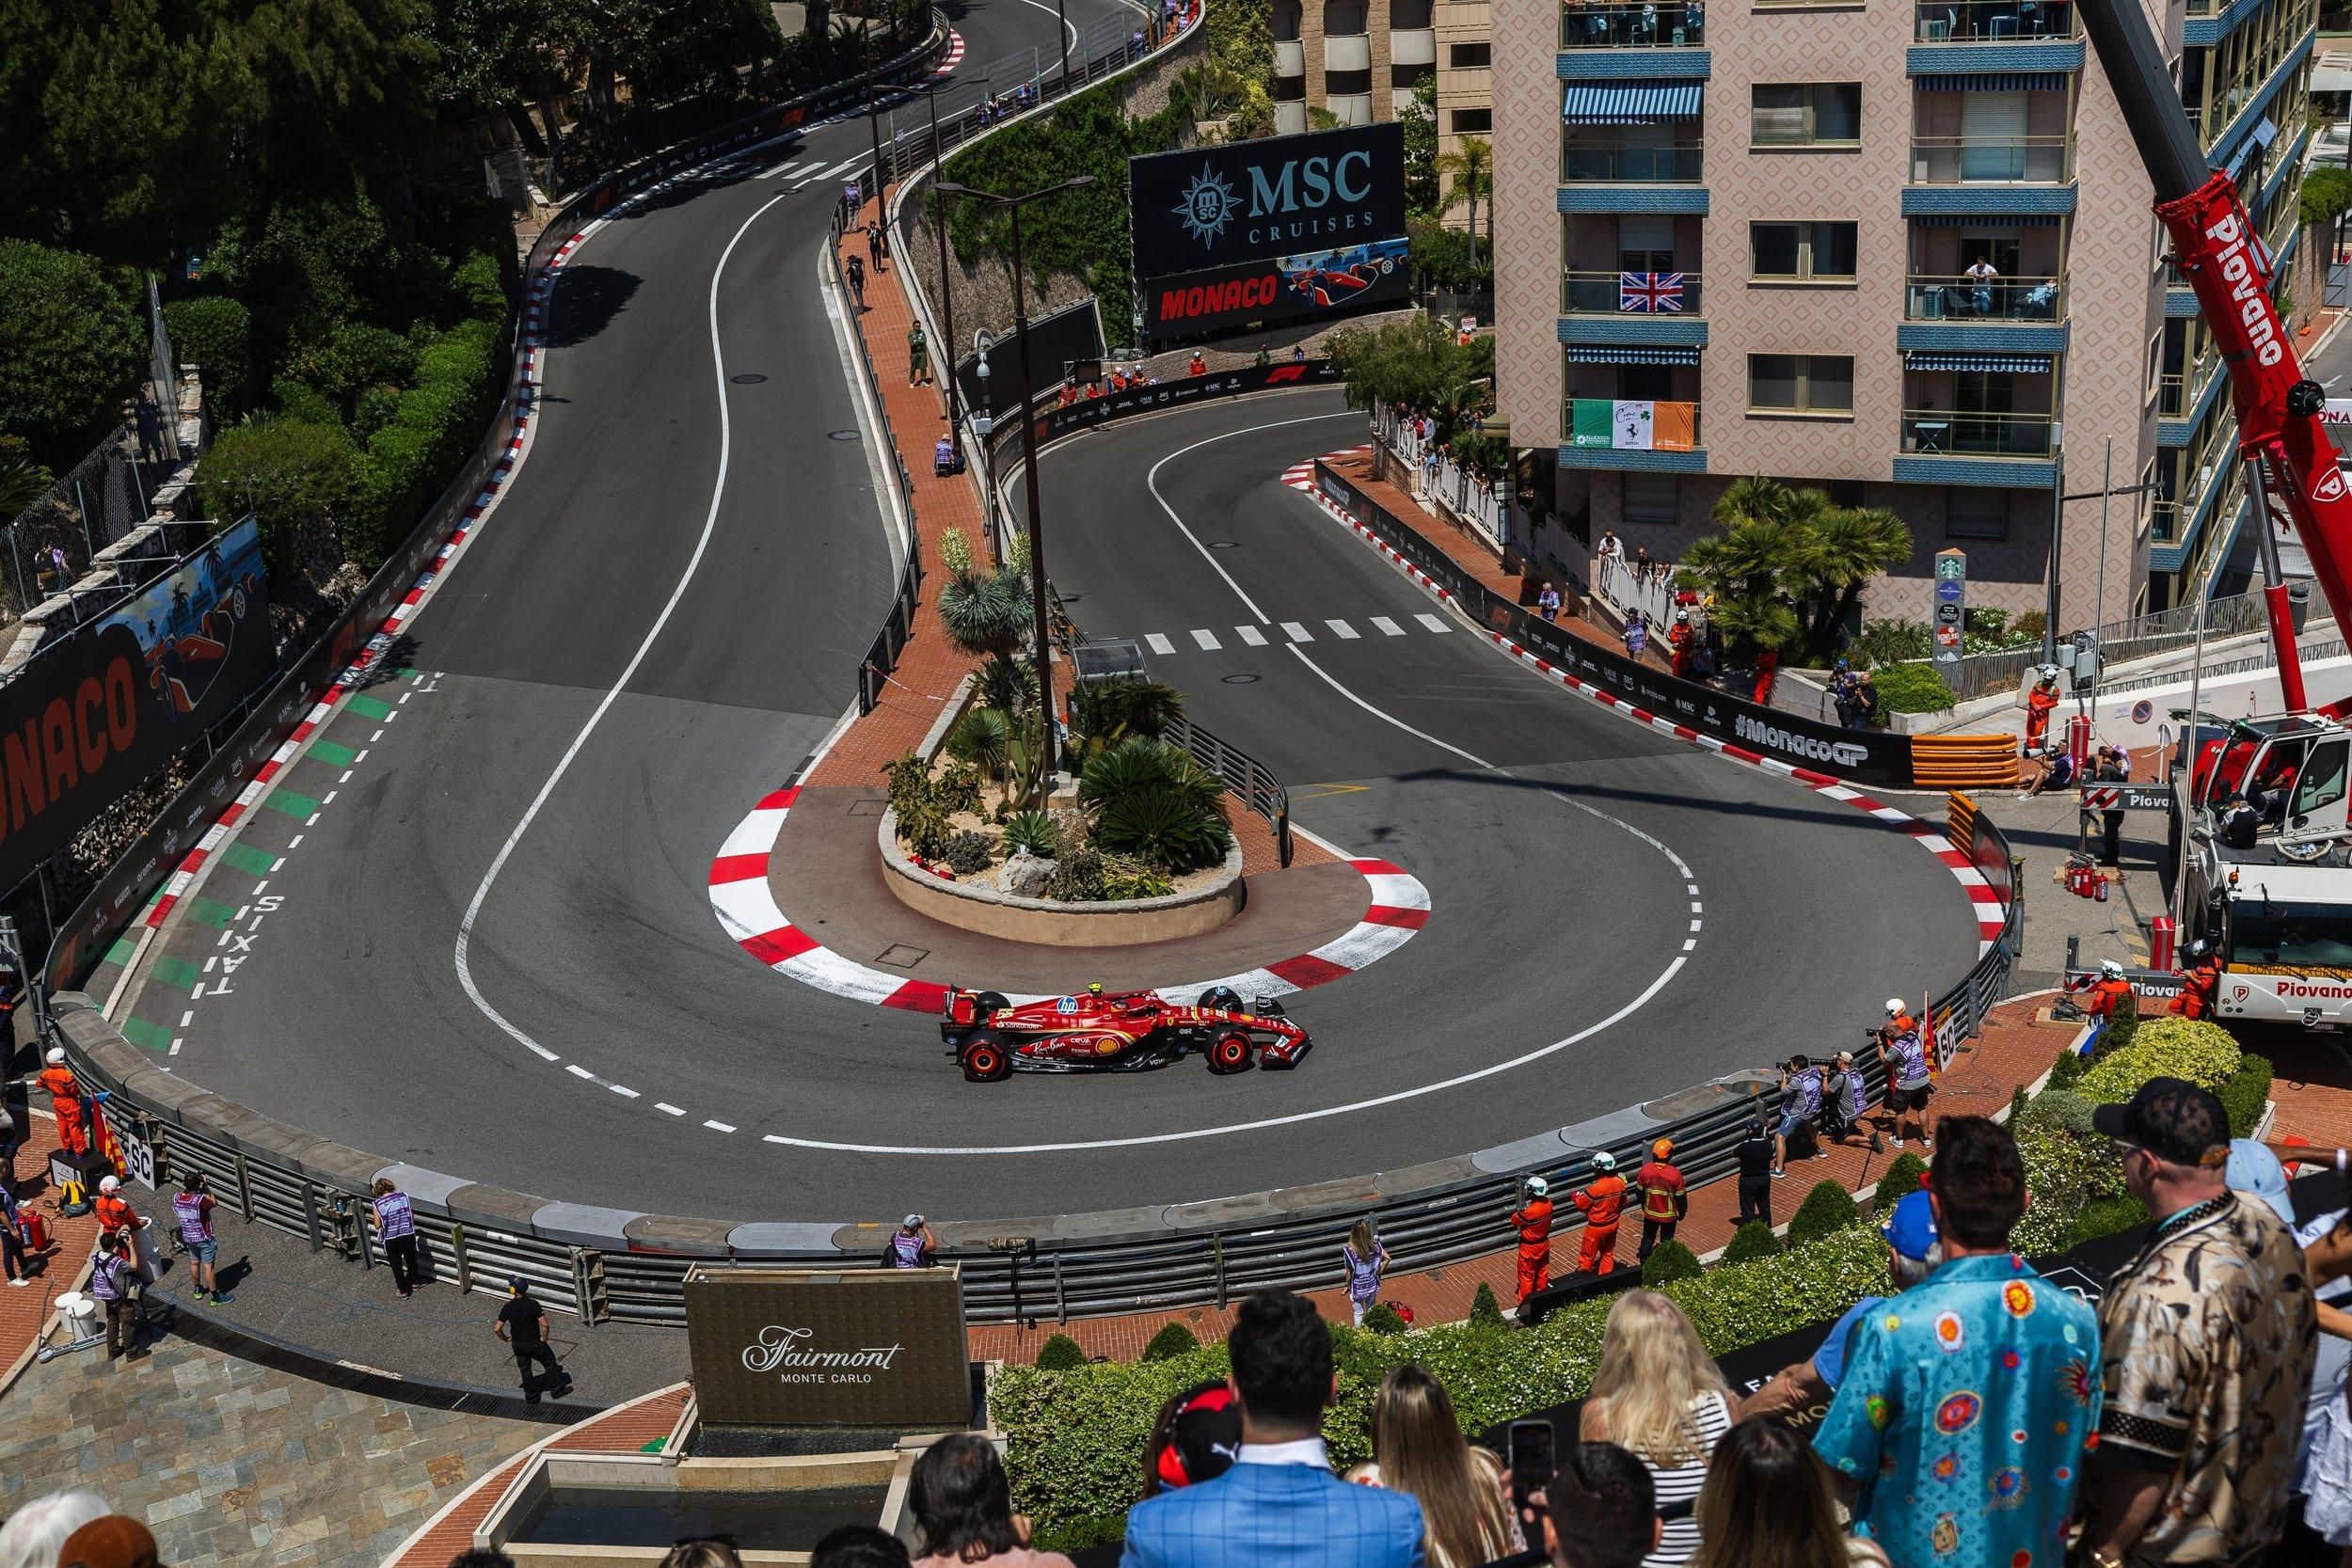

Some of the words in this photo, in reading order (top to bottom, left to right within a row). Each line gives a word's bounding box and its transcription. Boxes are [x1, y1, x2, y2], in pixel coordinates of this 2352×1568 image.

[1247, 150, 1372, 218] MSC
[1248, 212, 1374, 245] CRUISES
[1160, 275, 1278, 321] MONACO
[2205, 213, 2283, 368] Piovano
[0, 656, 136, 846] NACO
[206, 895, 285, 996] TAXIS
[1058, 997, 1077, 1014] hp
[2277, 981, 2352, 999] Piovano
[995, 1007, 1015, 1020] 55
[1005, 1021, 1043, 1029] Santander
[1940, 1025, 1956, 1064] SC
[131, 1143, 151, 1180] SC
[741, 1325, 905, 1372] Fairmont
[781, 1373, 825, 1384] MONTE
[831, 1373, 872, 1384] CARLO
